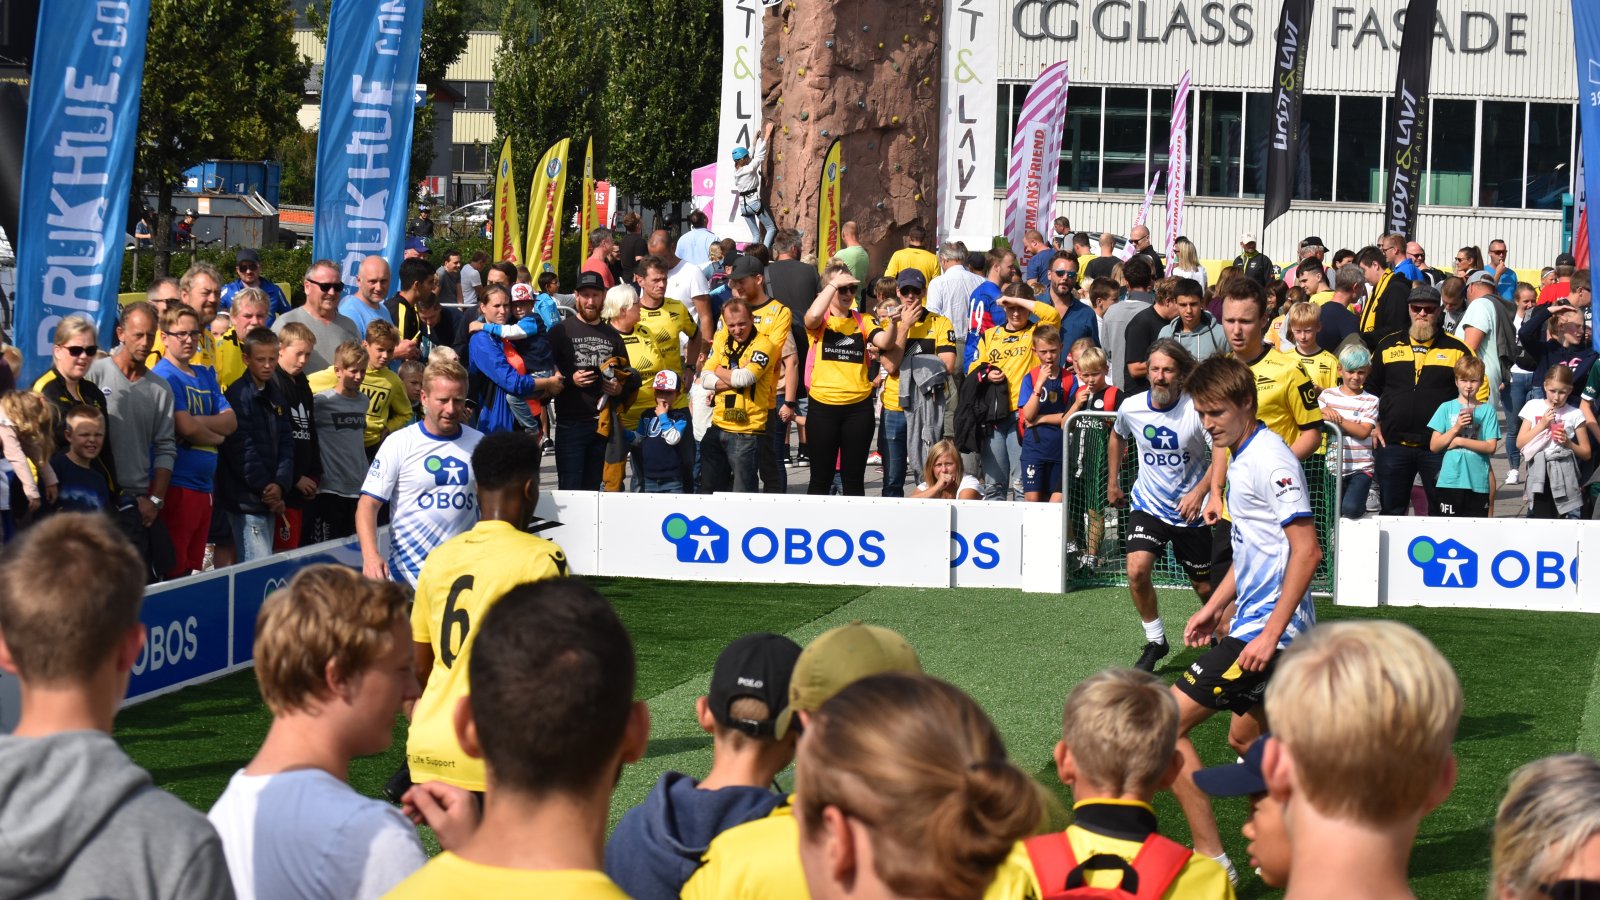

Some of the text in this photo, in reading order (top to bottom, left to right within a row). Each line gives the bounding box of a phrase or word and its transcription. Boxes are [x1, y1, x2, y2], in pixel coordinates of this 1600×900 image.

[1092, 0, 1254, 45] GLASS
[1280, 10, 1298, 70] LAVT
[734, 45, 755, 80] &
[954, 48, 983, 84] &
[1279, 69, 1296, 91] &
[1397, 78, 1416, 146] LAVT
[954, 94, 978, 229] LAVT
[1027, 129, 1047, 180] FRIEND
[1396, 143, 1412, 170] &
[1390, 350, 1405, 359] 1905
[1143, 452, 1191, 467] OBOS
[417, 491, 474, 510] OBOS
[741, 526, 886, 568] OBOS
[1491, 549, 1579, 590] OB
[440, 574, 475, 670] 6
[737, 677, 764, 689] POLO
[425, 756, 456, 768] Support
